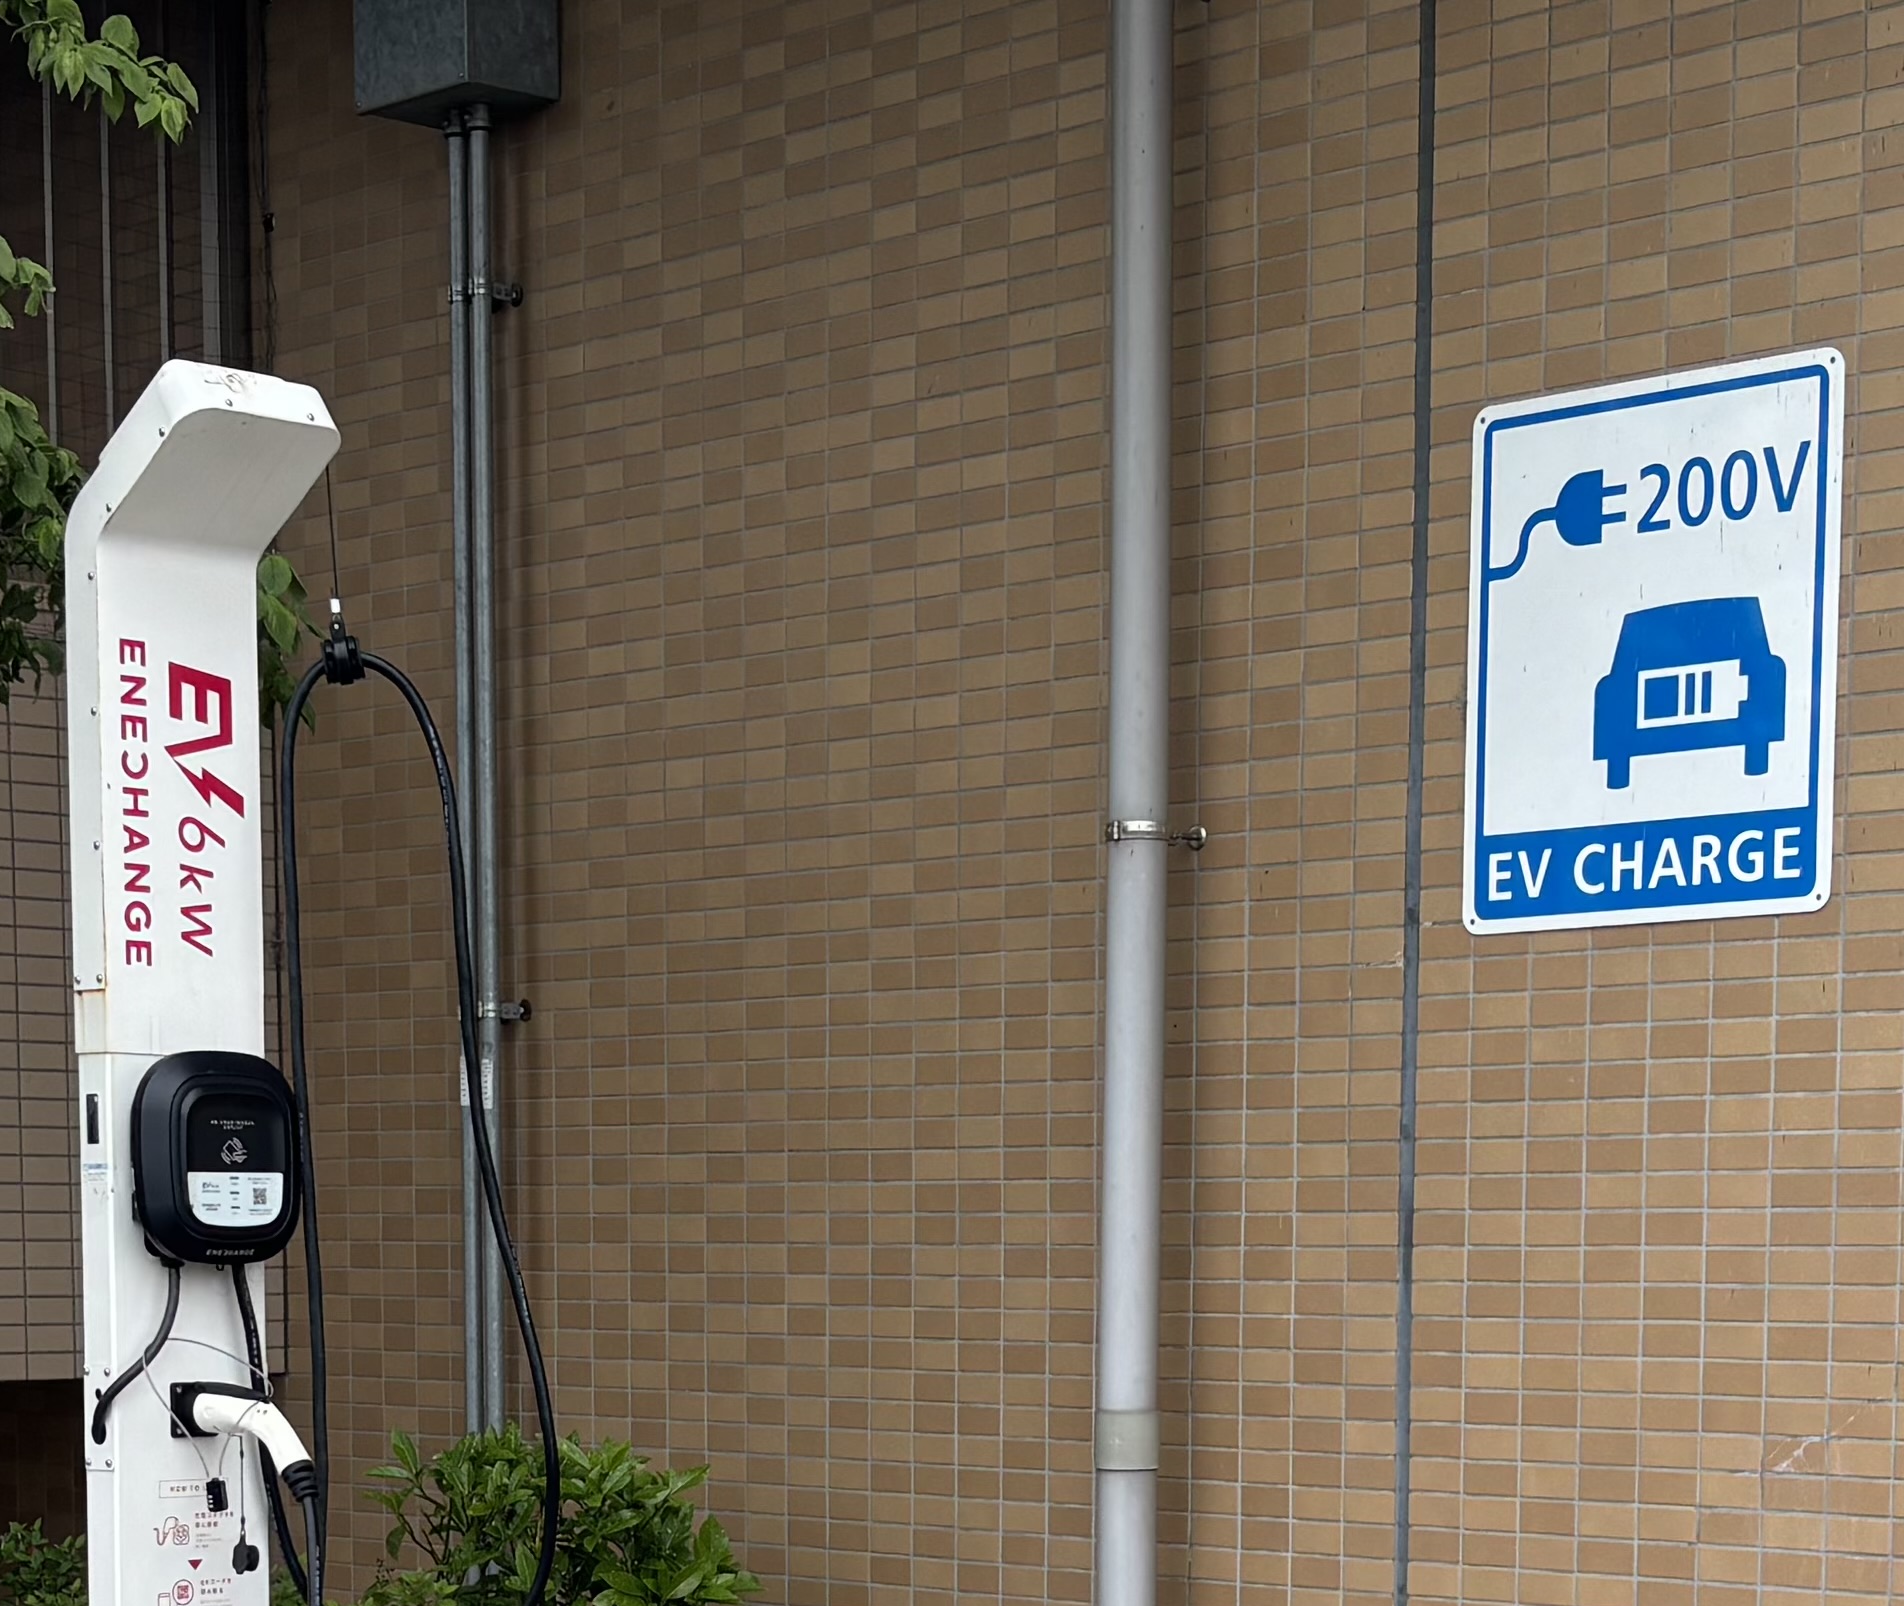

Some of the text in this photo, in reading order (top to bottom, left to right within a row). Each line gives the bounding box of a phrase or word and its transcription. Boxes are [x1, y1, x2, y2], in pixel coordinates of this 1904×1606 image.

[1636, 440, 1811, 534] 200V
[177, 816, 226, 958] 6kW
[1487, 826, 1802, 903] EV CHARGE
